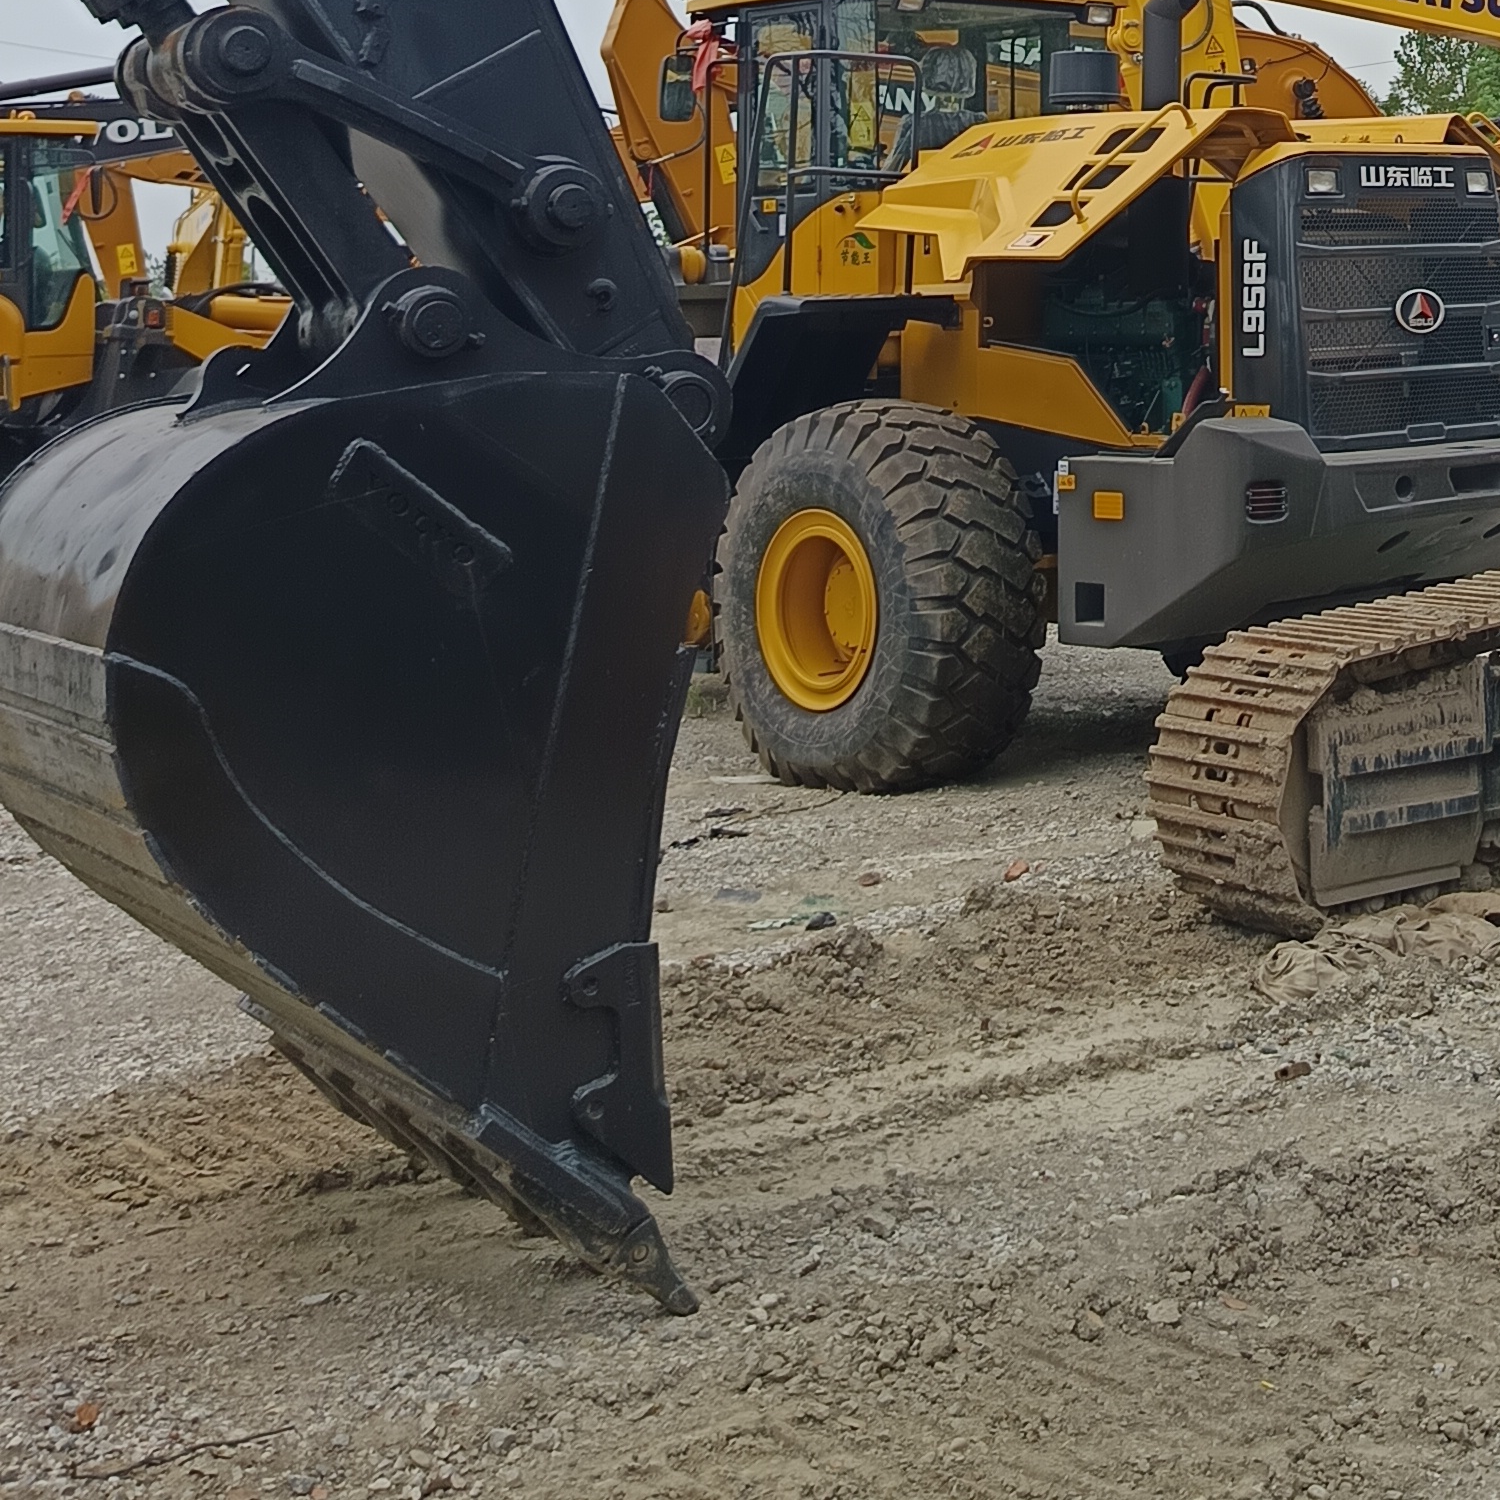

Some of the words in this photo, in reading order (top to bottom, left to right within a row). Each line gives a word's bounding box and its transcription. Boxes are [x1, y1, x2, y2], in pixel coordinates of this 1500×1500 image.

[991, 126, 1096, 149] 山东临工
[1360, 166, 1455, 188] 山东临工
[1242, 238, 1267, 357] L956F
